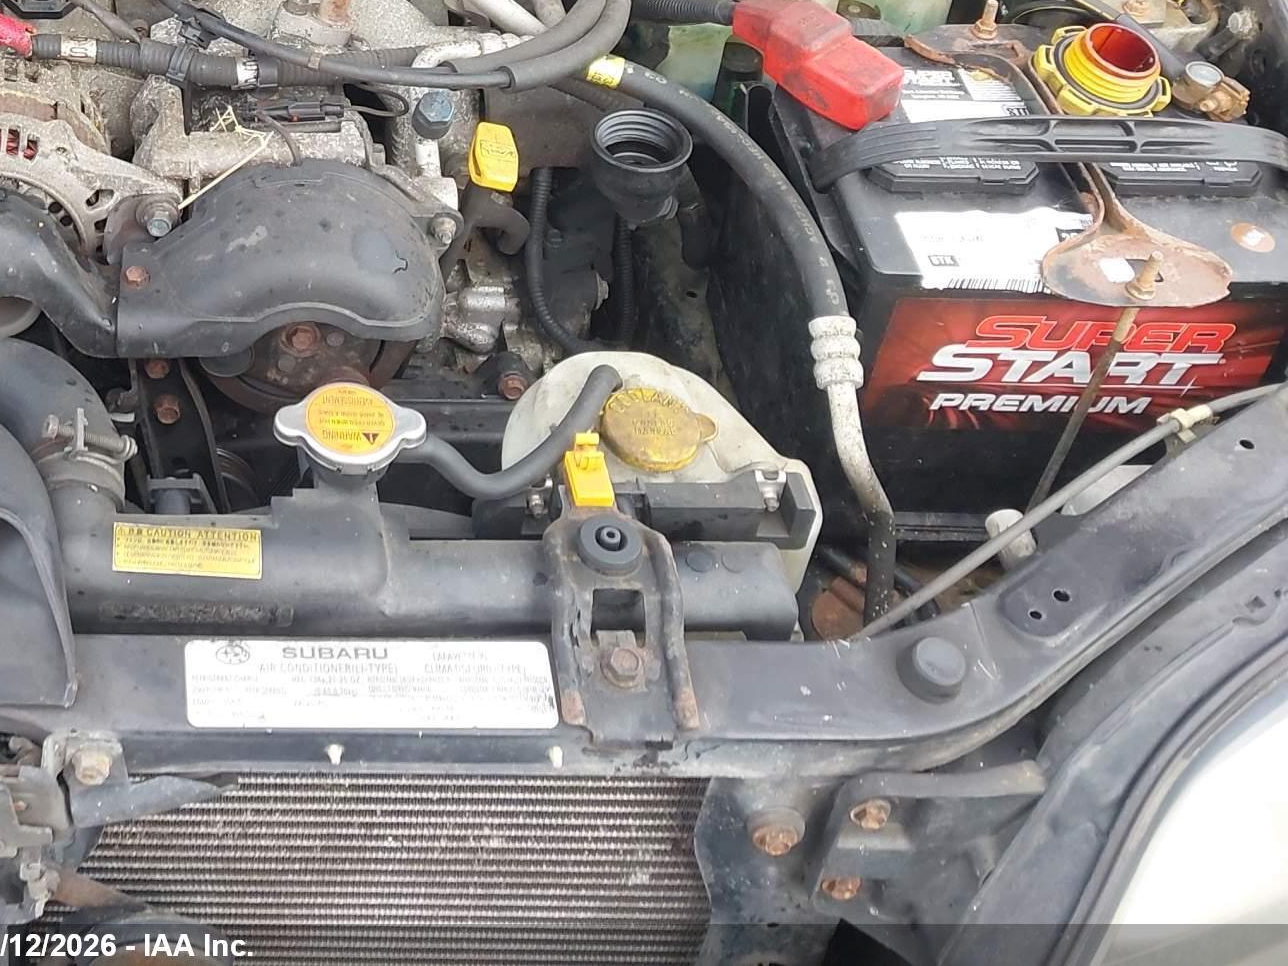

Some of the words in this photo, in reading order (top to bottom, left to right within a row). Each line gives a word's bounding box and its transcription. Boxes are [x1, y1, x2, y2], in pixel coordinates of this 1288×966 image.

[967, 315, 1237, 353] SUPER
[917, 343, 1226, 386] START
[930, 392, 1153, 415] PREMIUM
[322, 429, 363, 441] WARNING
[146, 529, 191, 538] CAUTION
[197, 530, 258, 541] ATTENTION
[282, 646, 389, 660] SUBARU
